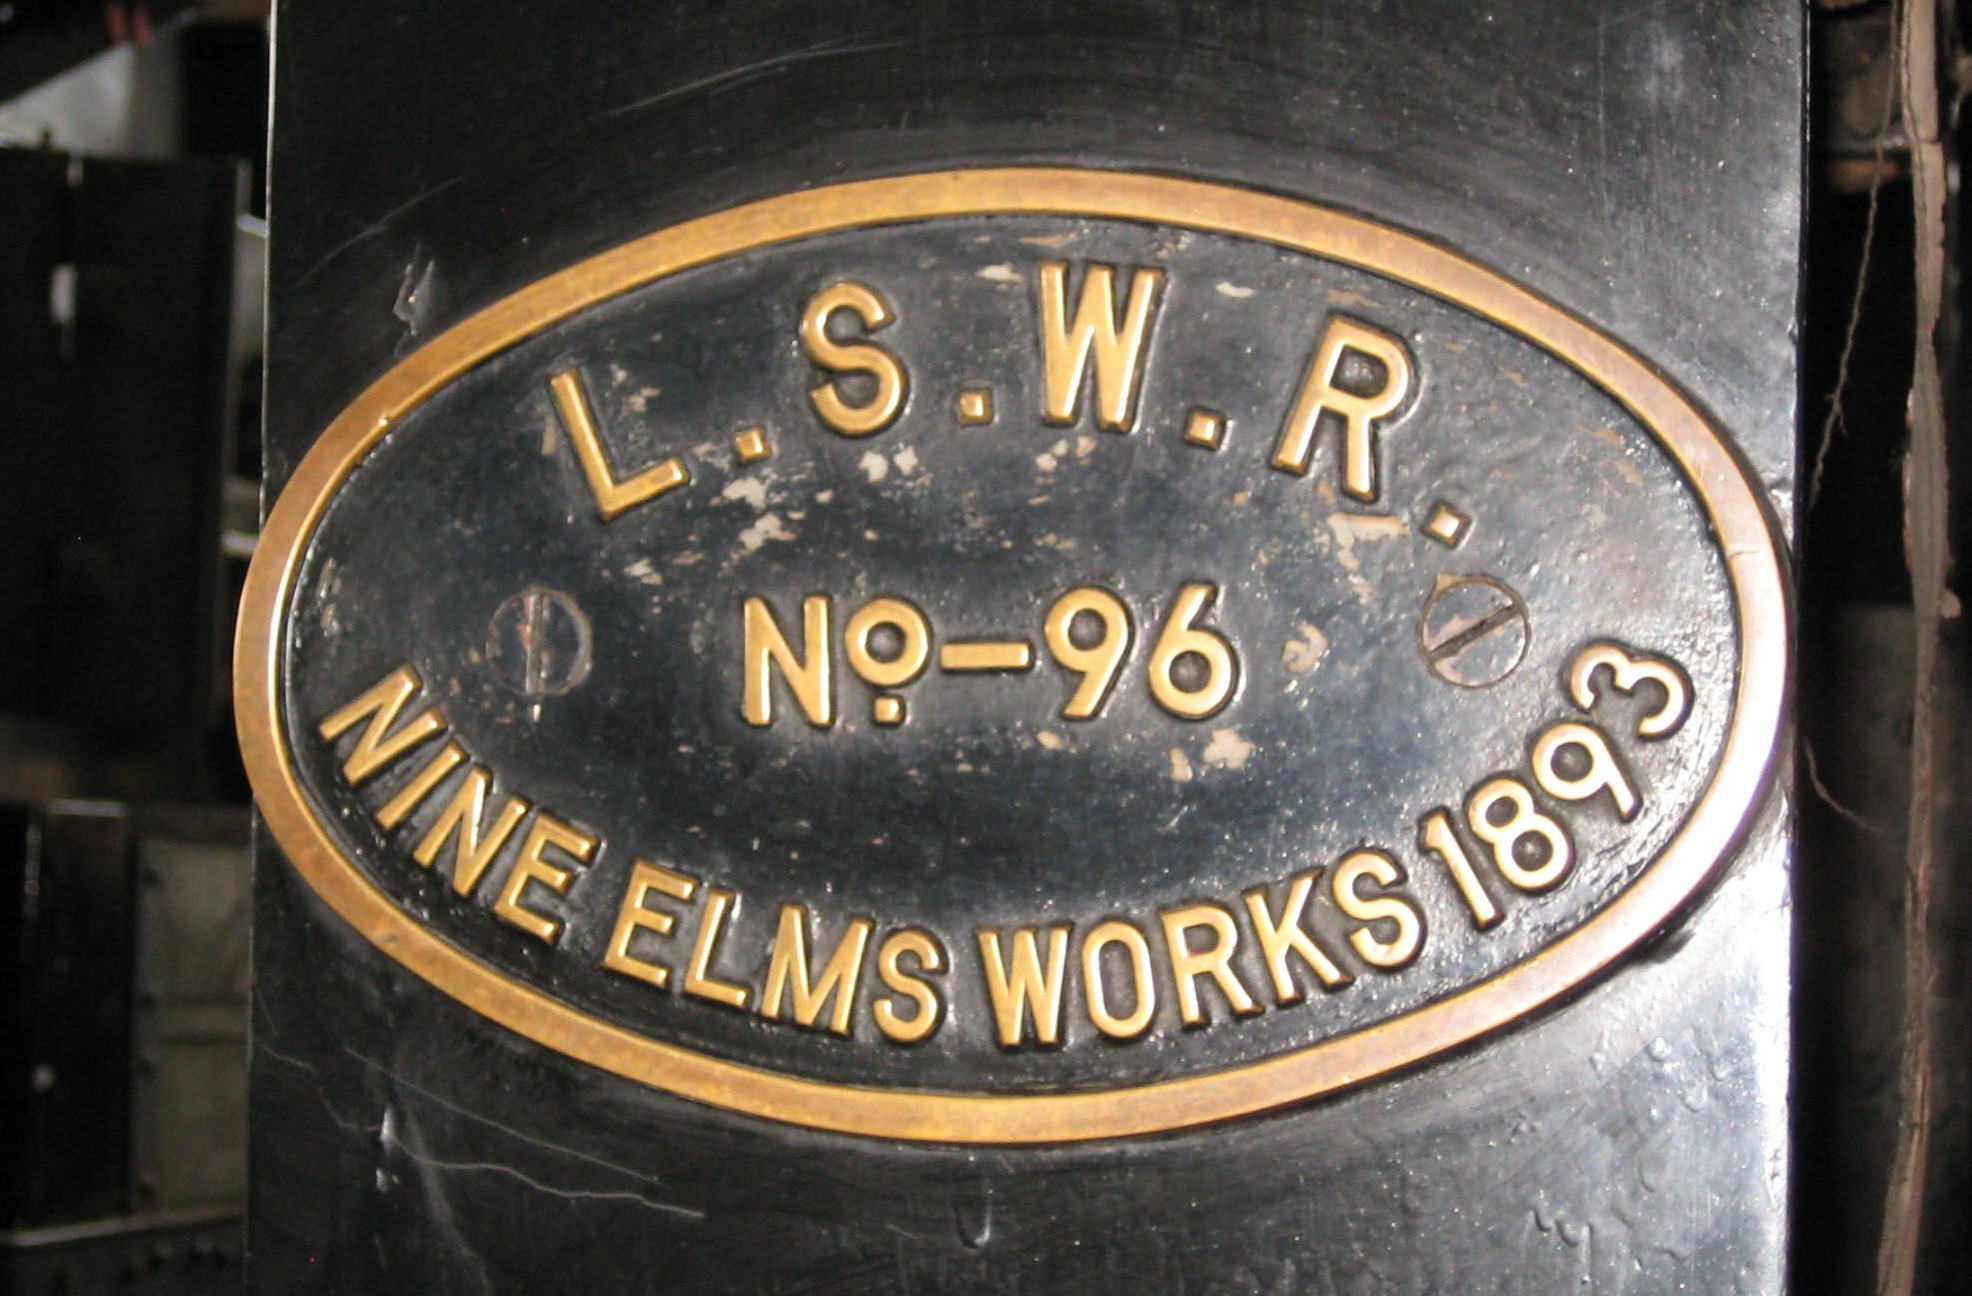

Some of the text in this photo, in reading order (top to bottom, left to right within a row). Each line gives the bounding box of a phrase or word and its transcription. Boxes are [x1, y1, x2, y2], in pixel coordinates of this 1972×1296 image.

[318, 644, 1693, 1048] NINE ELMS WORKS 1893
